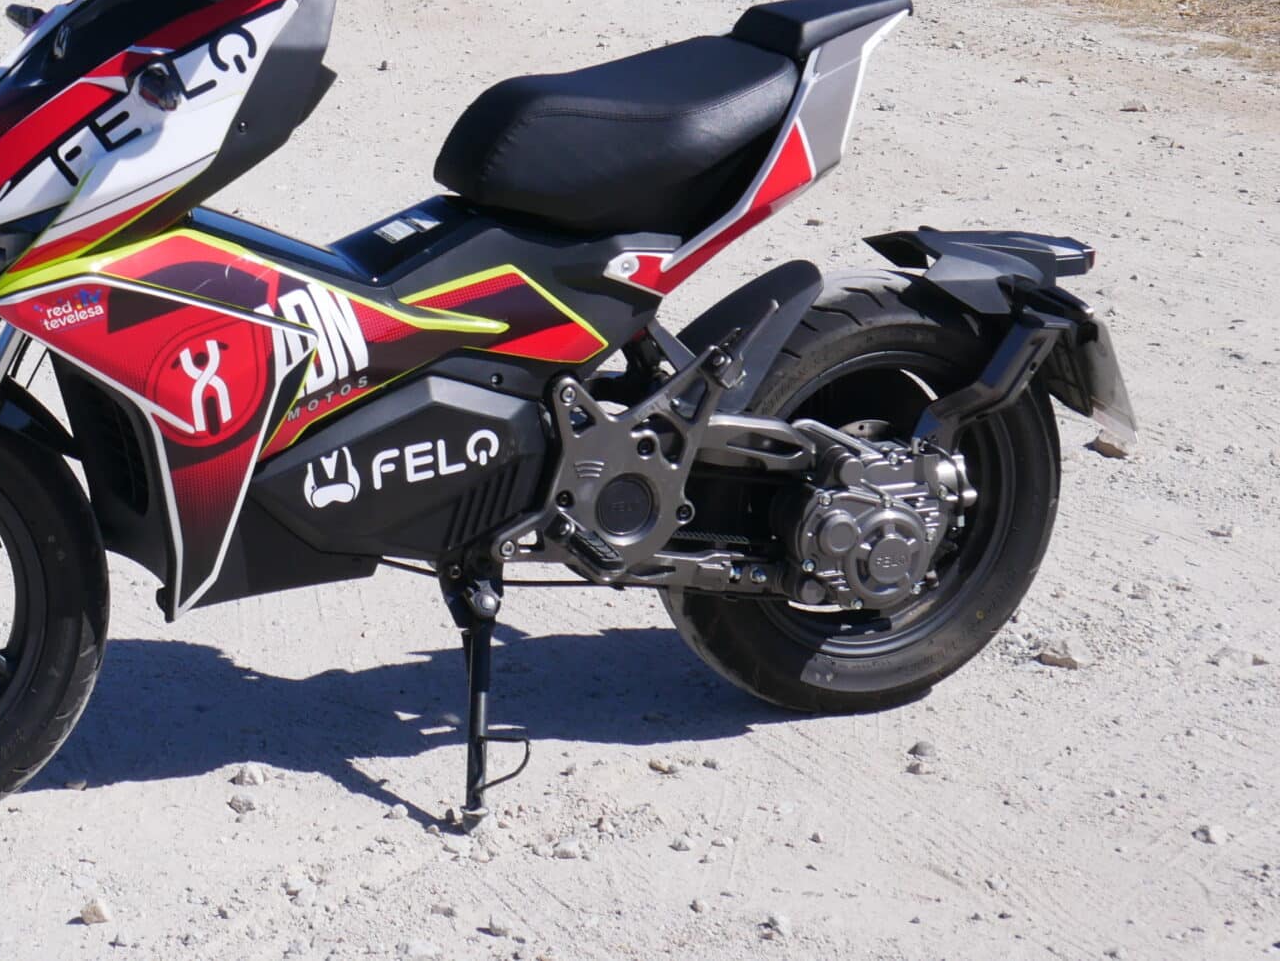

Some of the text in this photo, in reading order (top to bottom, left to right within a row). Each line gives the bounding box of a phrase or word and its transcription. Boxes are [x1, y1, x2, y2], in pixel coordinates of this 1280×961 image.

[43, 304, 105, 331] tevelesa
[46, 299, 73, 320] red
[286, 375, 369, 422] MOTOS
